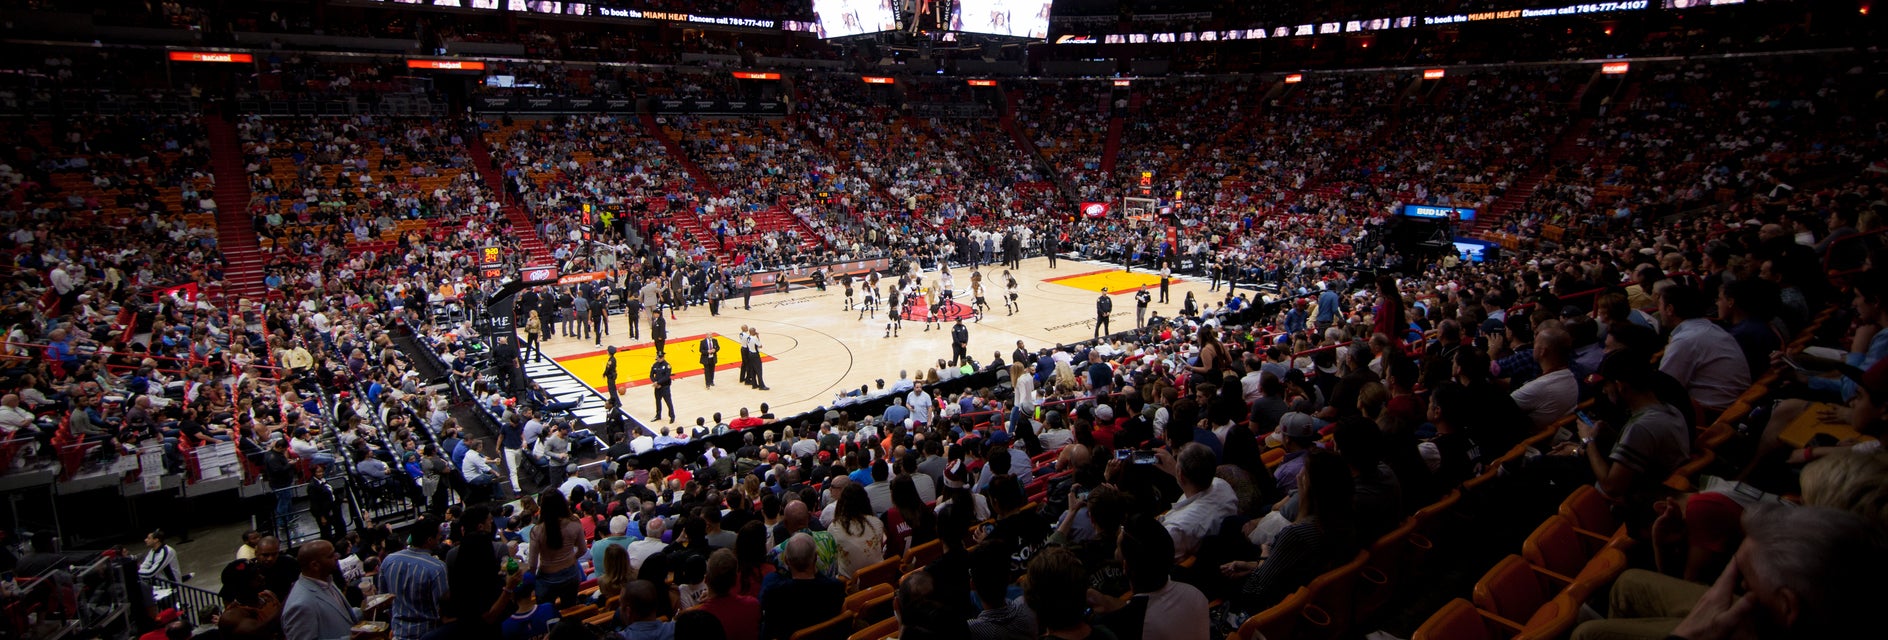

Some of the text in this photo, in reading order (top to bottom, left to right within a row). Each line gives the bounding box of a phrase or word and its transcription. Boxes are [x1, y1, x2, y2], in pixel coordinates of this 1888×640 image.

[600, 8, 774, 28] To book the MIAMI HEAT Dancers call 786-777-4107
[1424, 0, 1647, 25] To book the MIAMI HEAT Dancers call 786-777-4107
[1416, 208, 1435, 216] BUD
